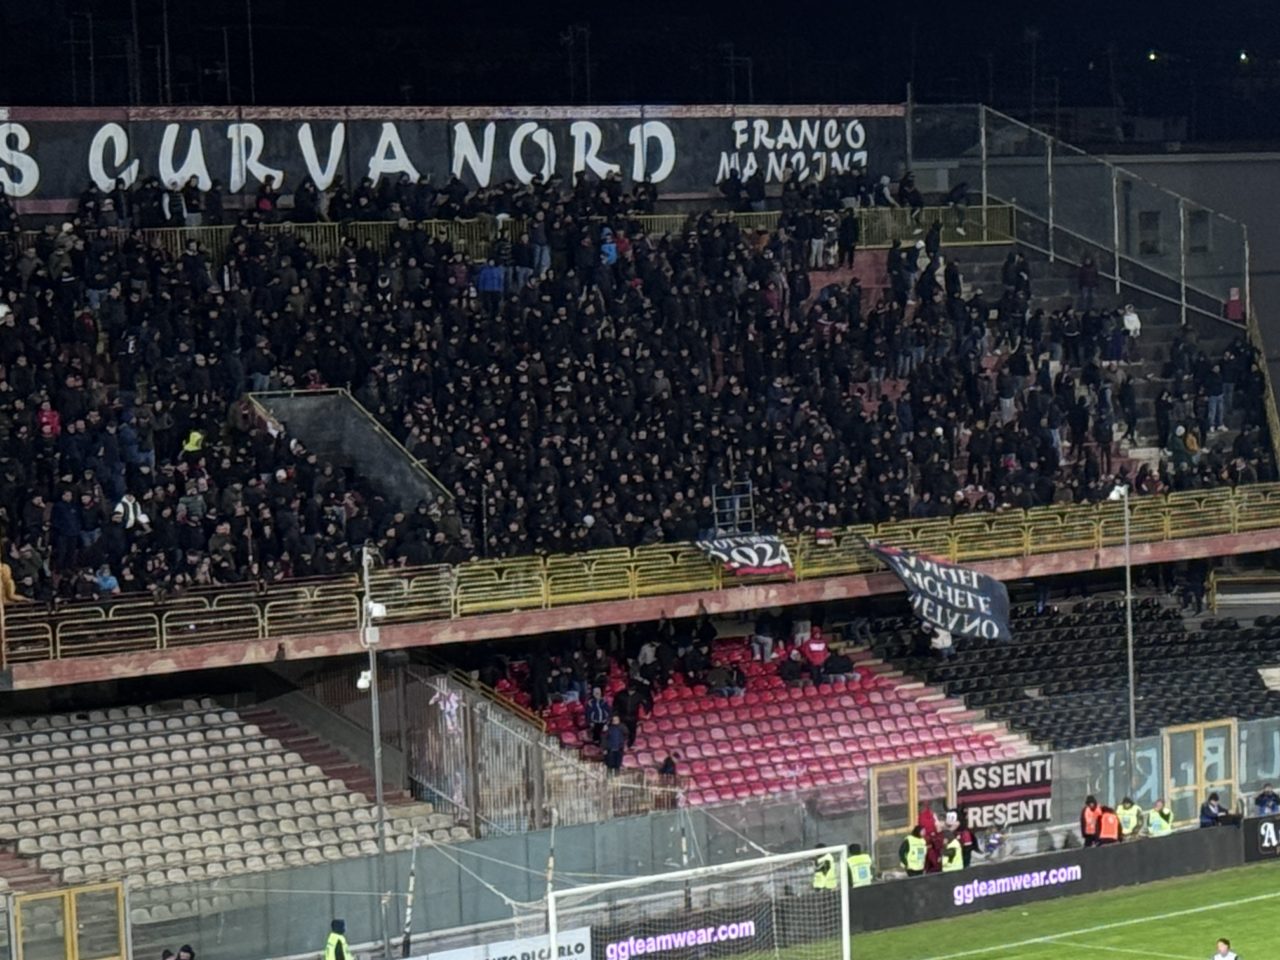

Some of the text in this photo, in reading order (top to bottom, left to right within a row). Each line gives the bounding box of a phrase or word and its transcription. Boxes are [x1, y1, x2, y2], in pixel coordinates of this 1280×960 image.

[732, 119, 866, 150] FRANCO
[88, 121, 423, 193] CURVA
[452, 121, 676, 188] NORD
[957, 759, 1052, 791] ASSENTI
[965, 798, 1052, 829] RESENTI
[953, 865, 1082, 906] ggteamwear.com
